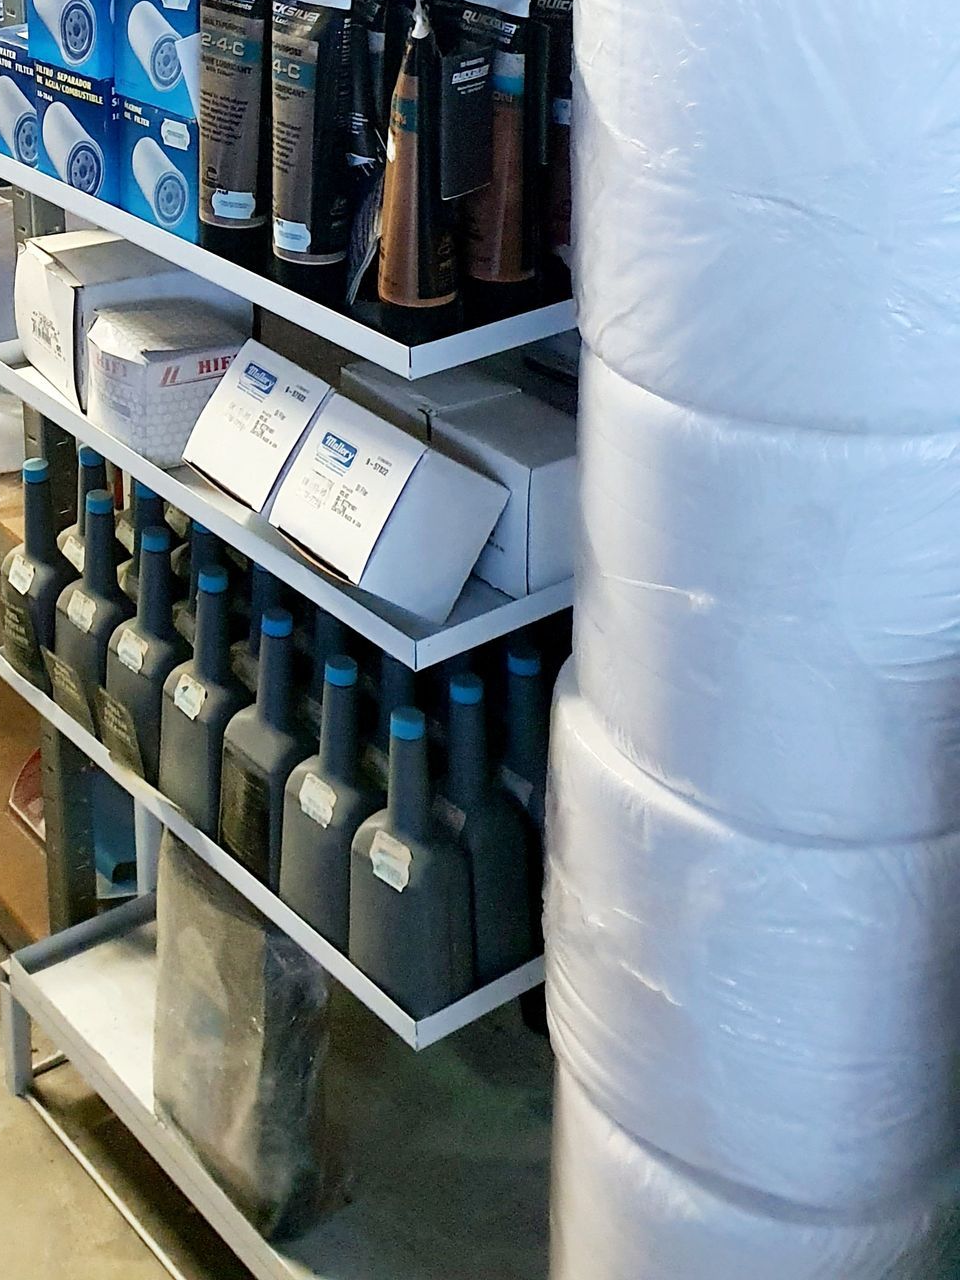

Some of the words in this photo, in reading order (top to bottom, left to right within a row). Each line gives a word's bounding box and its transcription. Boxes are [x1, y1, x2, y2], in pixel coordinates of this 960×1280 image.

[15, 62, 34, 77] FILTER
[56, 71, 92, 90] SEPARADOR
[247, 364, 275, 391] Mallory
[324, 434, 355, 464] Mallory
